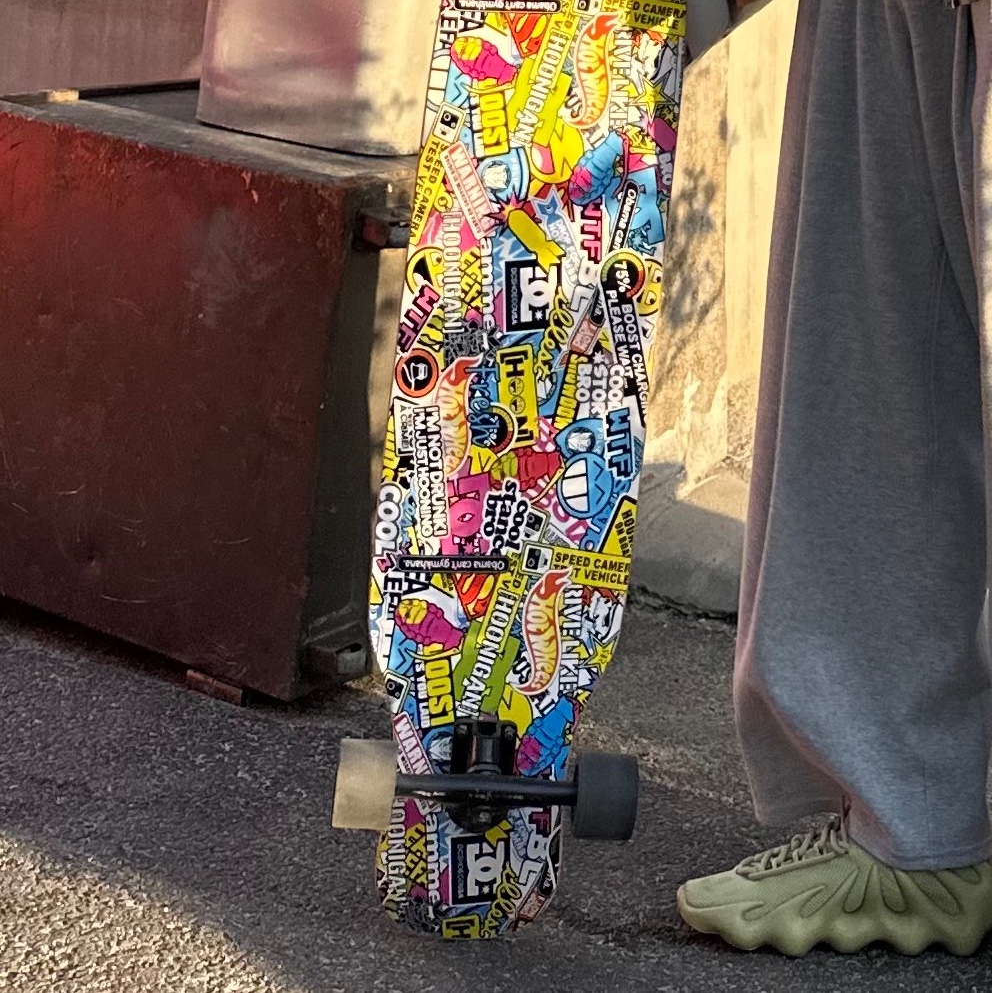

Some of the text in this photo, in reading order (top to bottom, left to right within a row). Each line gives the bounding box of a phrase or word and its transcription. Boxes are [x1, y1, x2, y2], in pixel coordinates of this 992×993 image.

[634, 13, 680, 31] VEHICLE
[642, 2, 686, 20] CAMERA
[612, 27, 634, 75] RIVE
[478, 78, 509, 156] OOST
[422, 140, 441, 173] TEST
[410, 144, 448, 238] SEED CAMERA
[620, 188, 637, 229] Obama
[442, 210, 465, 334] [HOONIGAN]
[613, 261, 632, 294] 75%
[397, 284, 441, 353] WTF
[605, 290, 627, 343] PLEASE
[575, 363, 593, 402] BRO
[591, 364, 608, 414] STOR
[621, 304, 649, 423] BOOST CHARGIN
[466, 366, 500, 447] Fresh
[553, 354, 589, 430] SHOWDOW
[415, 431, 428, 466] JUST
[428, 436, 443, 473] NOT
[605, 407, 634, 479] WTF
[375, 485, 402, 556] COOL
[418, 467, 433, 538] HOONING
[483, 495, 498, 537] bro
[490, 479, 518, 556] stance
[505, 500, 529, 551] cool
[450, 560, 473, 570] can't
[474, 560, 505, 571] Obama
[555, 552, 591, 568] SPEED
[559, 584, 583, 695] RIVE LIKE
[424, 643, 455, 727] OOST
[395, 716, 432, 774] WARN
